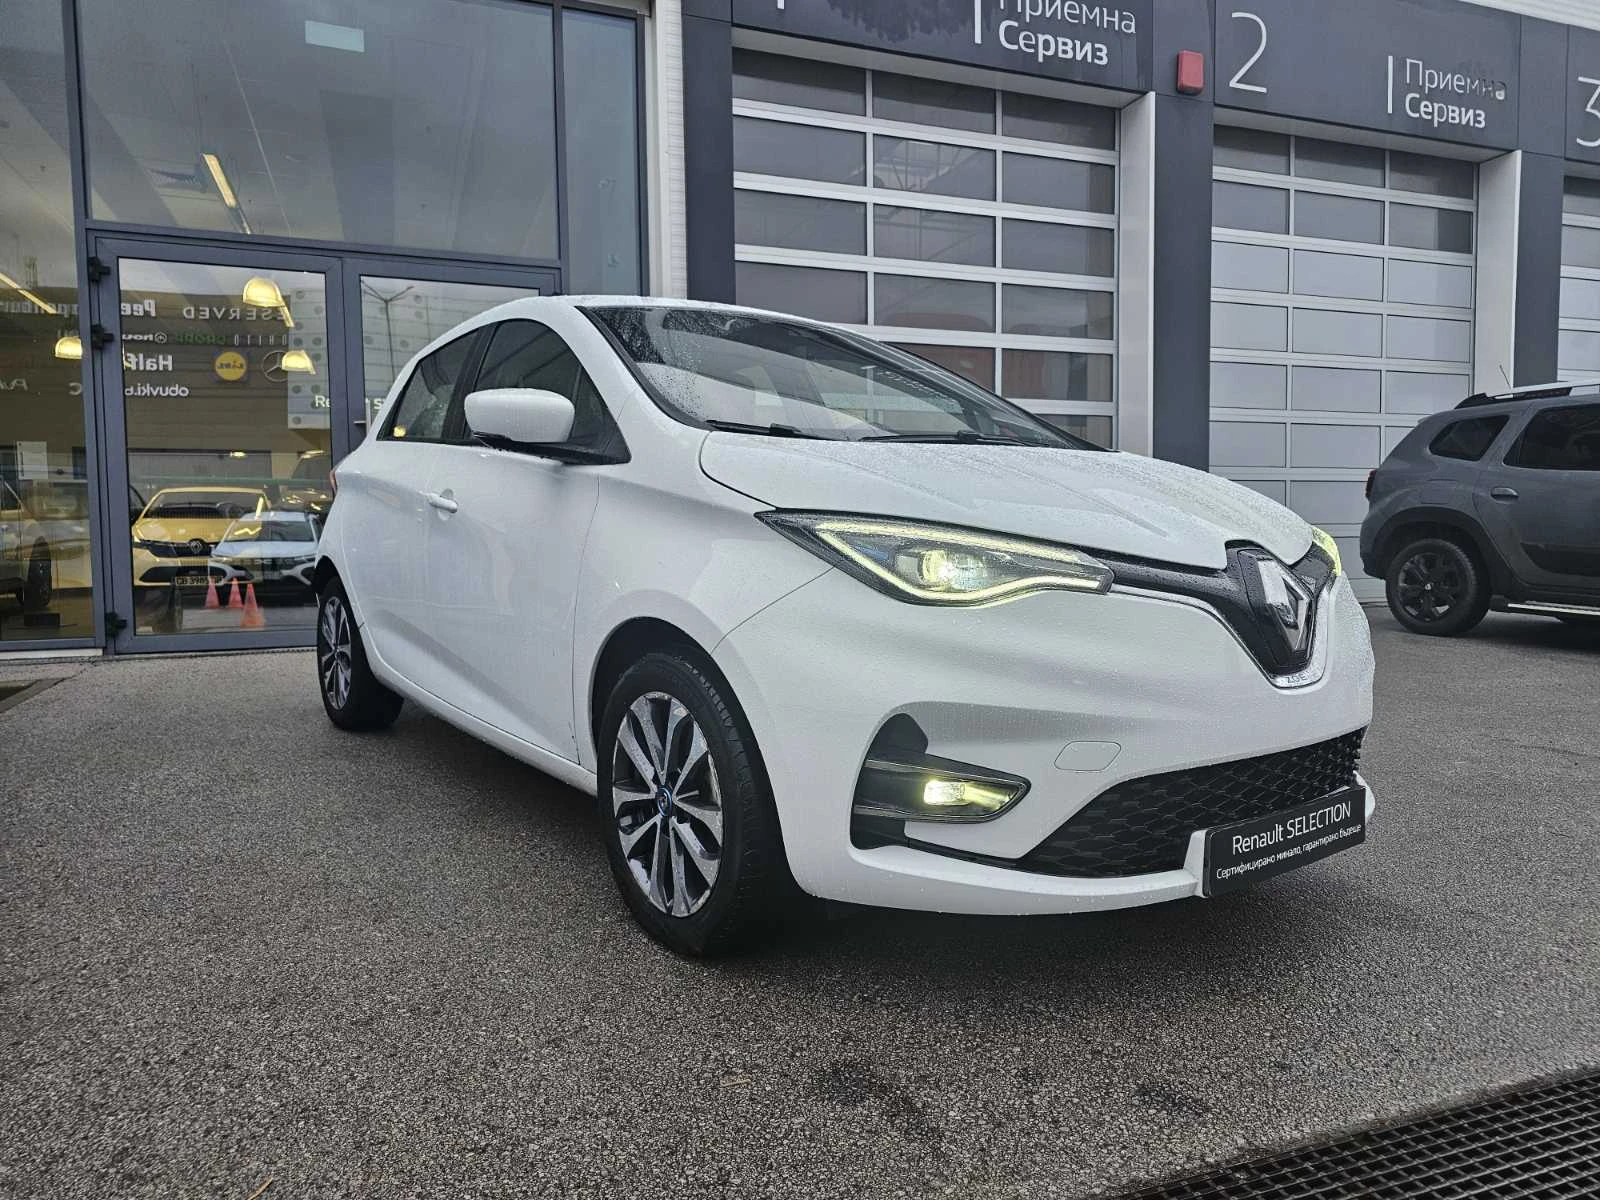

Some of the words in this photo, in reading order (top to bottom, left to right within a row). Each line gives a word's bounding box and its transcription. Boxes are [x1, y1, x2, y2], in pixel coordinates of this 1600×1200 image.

[998, 19, 1109, 65] Сервиз
[1229, 11, 1267, 94] 2
[1406, 58, 1505, 100] Приемна
[1405, 92, 1486, 128] Сервиз
[1576, 76, 1600, 147] 3
[1216, 854, 1275, 879] Сертифицирано
[1276, 845, 1302, 863] минало,
[1302, 834, 1339, 852] гарантирано
[1339, 824, 1362, 840] бъдеще
[1232, 823, 1284, 856] Renault
[1286, 800, 1351, 839] SELECTION
